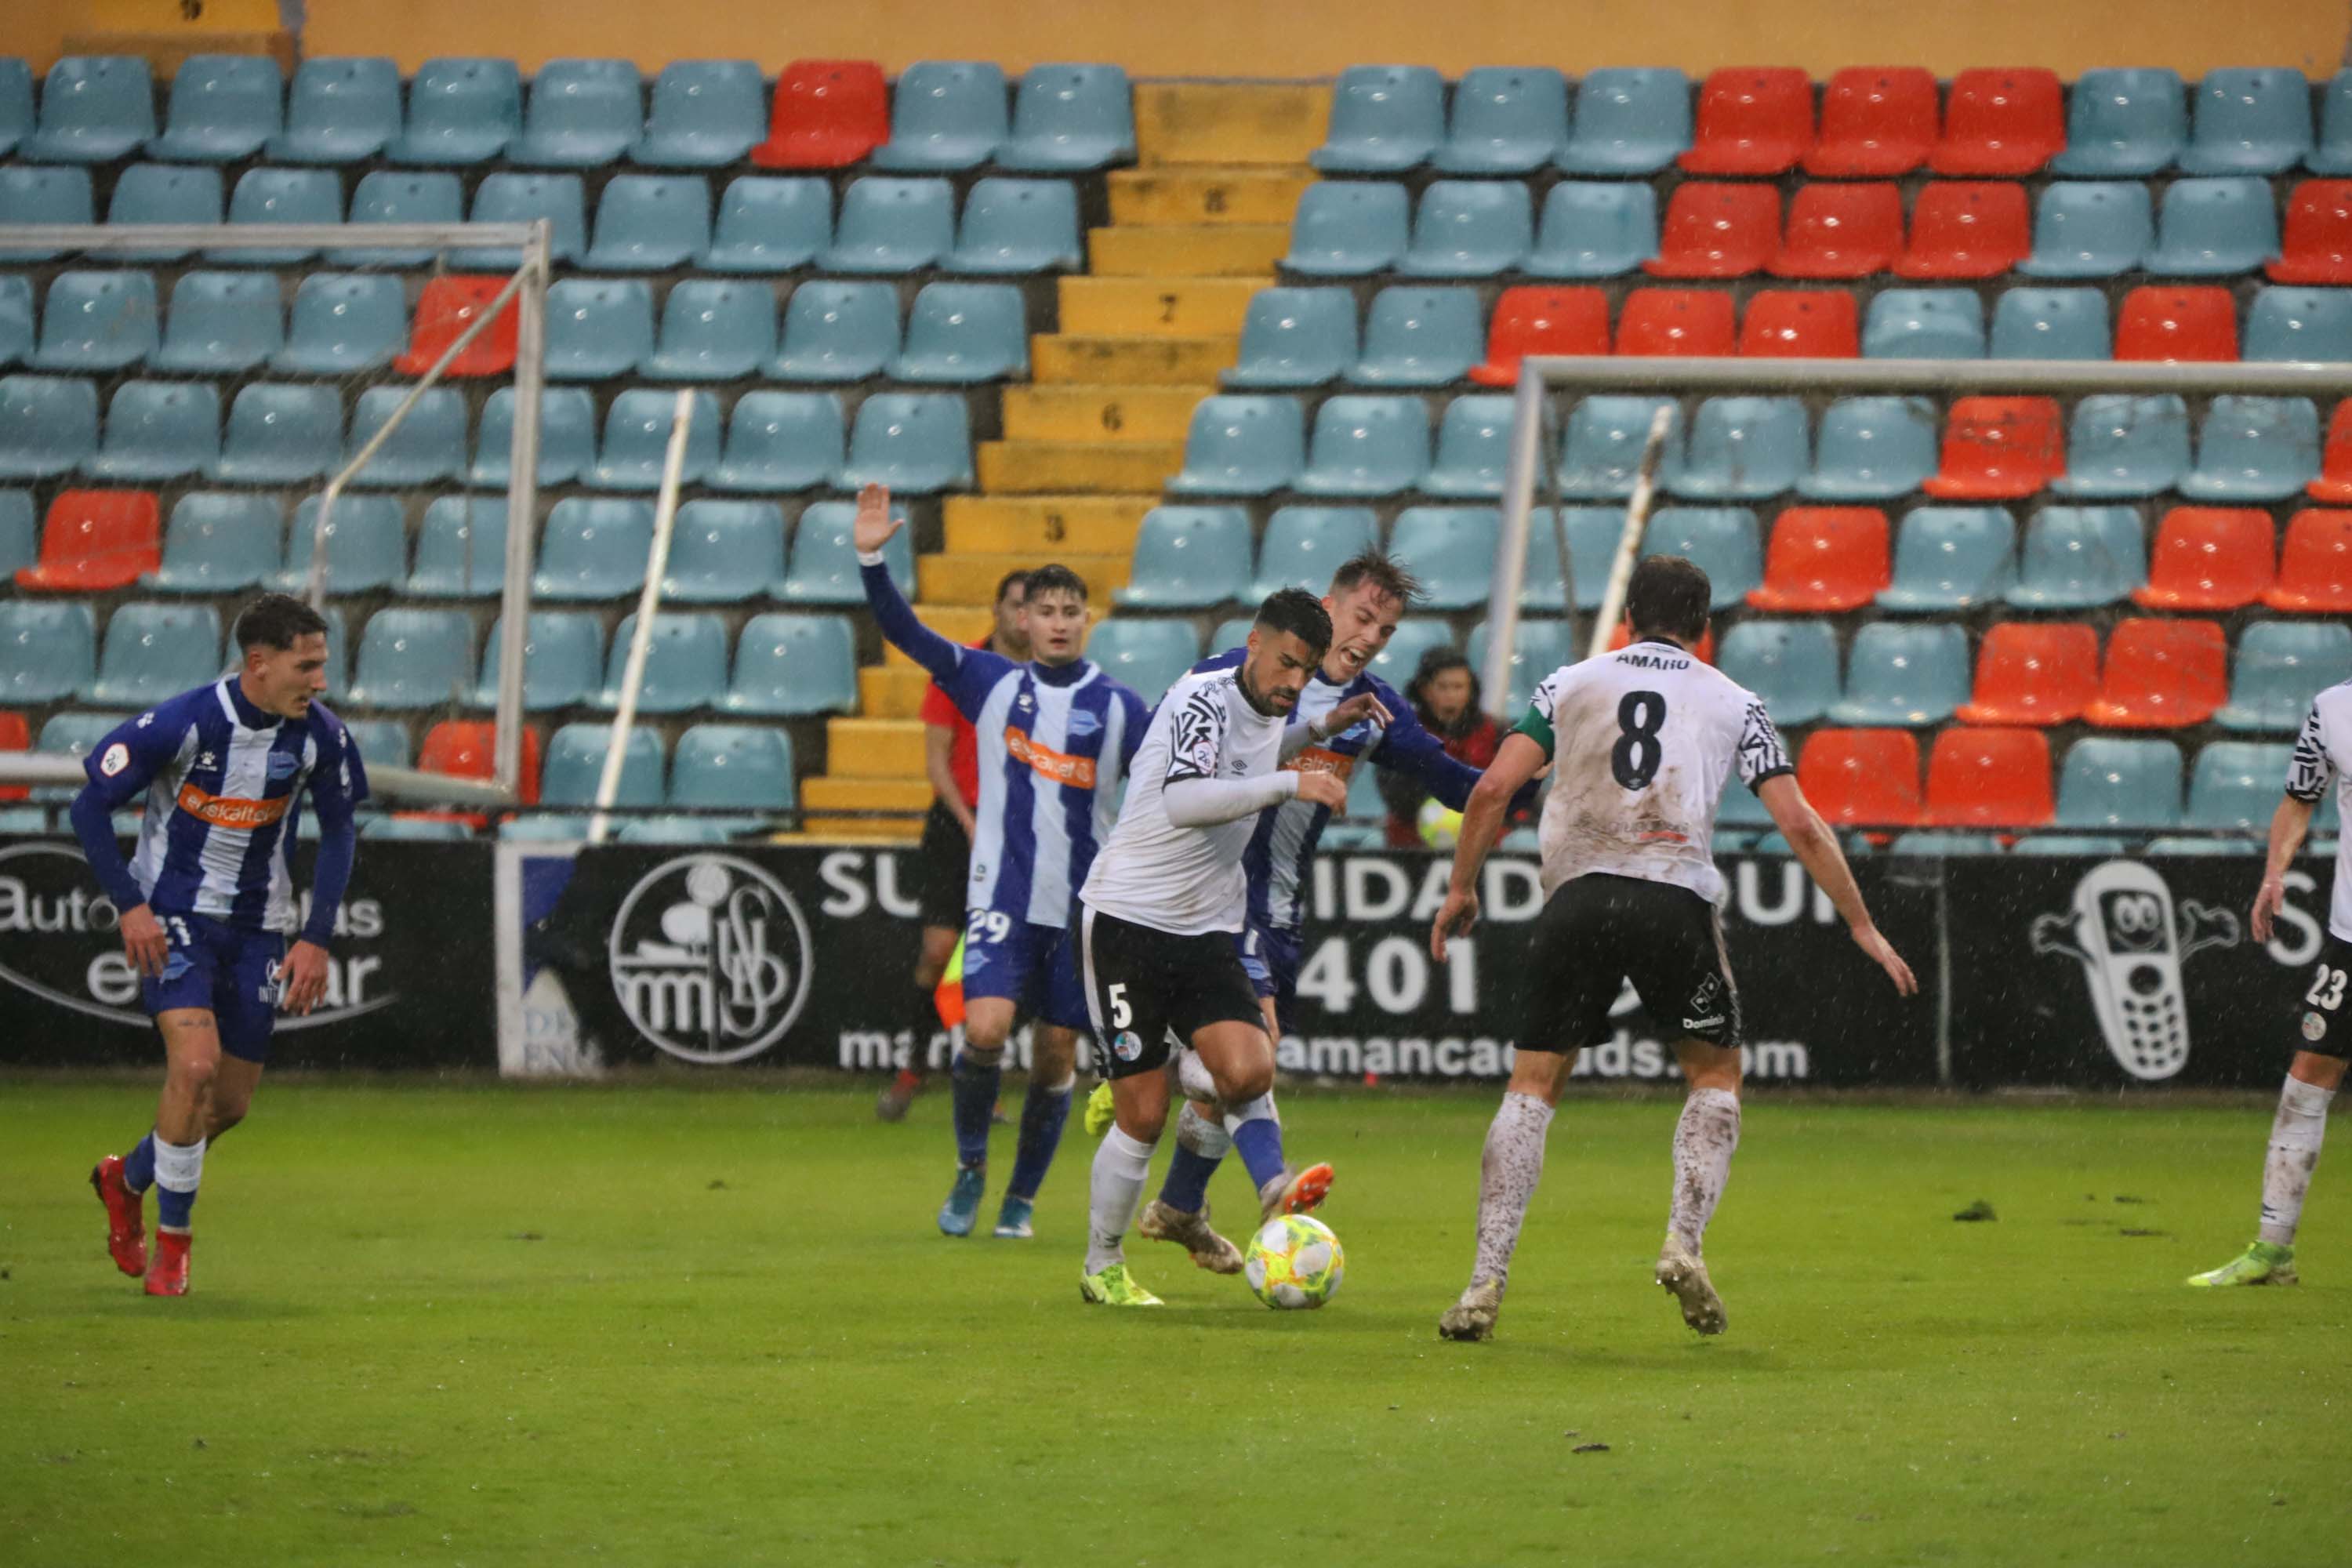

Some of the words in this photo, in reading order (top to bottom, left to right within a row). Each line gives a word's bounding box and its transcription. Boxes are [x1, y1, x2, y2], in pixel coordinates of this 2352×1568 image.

[1102, 403, 1123, 432] 6
[1611, 690, 1667, 791] 8
[965, 909, 1011, 944] 29
[1295, 936, 1478, 1014] 401
[2305, 964, 2348, 1011] 23
[1109, 982, 1133, 1029] 5
